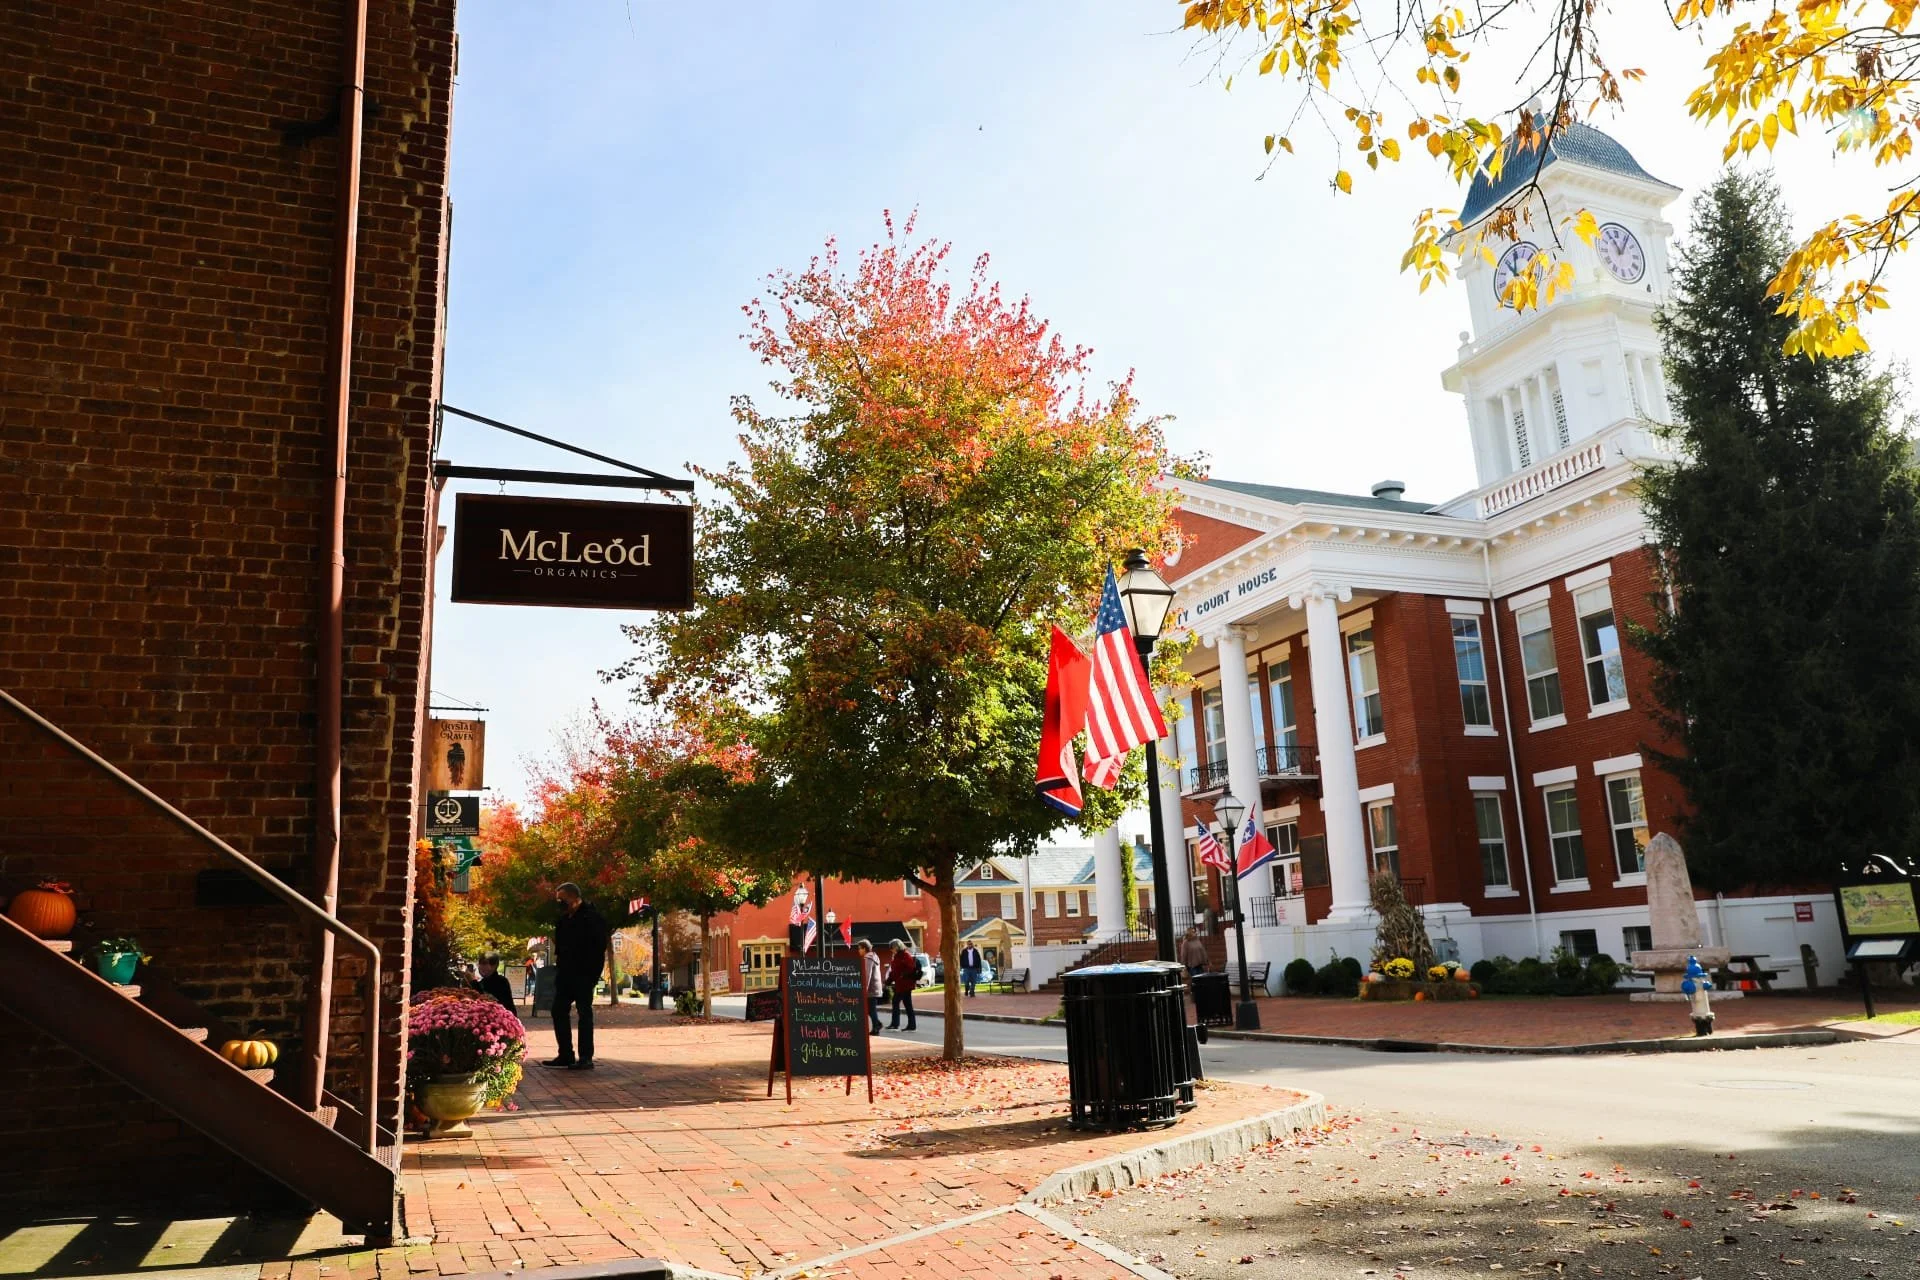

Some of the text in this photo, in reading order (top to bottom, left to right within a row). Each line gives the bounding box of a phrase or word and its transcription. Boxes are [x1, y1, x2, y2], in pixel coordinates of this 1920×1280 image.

[499, 528, 652, 566] McLeod
[534, 567, 617, 579] ORGANICS
[1196, 590, 1230, 615] COURT
[1238, 567, 1277, 596] HOUSE
[440, 730, 473, 741] RAVEN
[794, 1008, 836, 1022] Essential
[839, 1009, 857, 1022] Oils
[801, 1024, 830, 1039] Herbal
